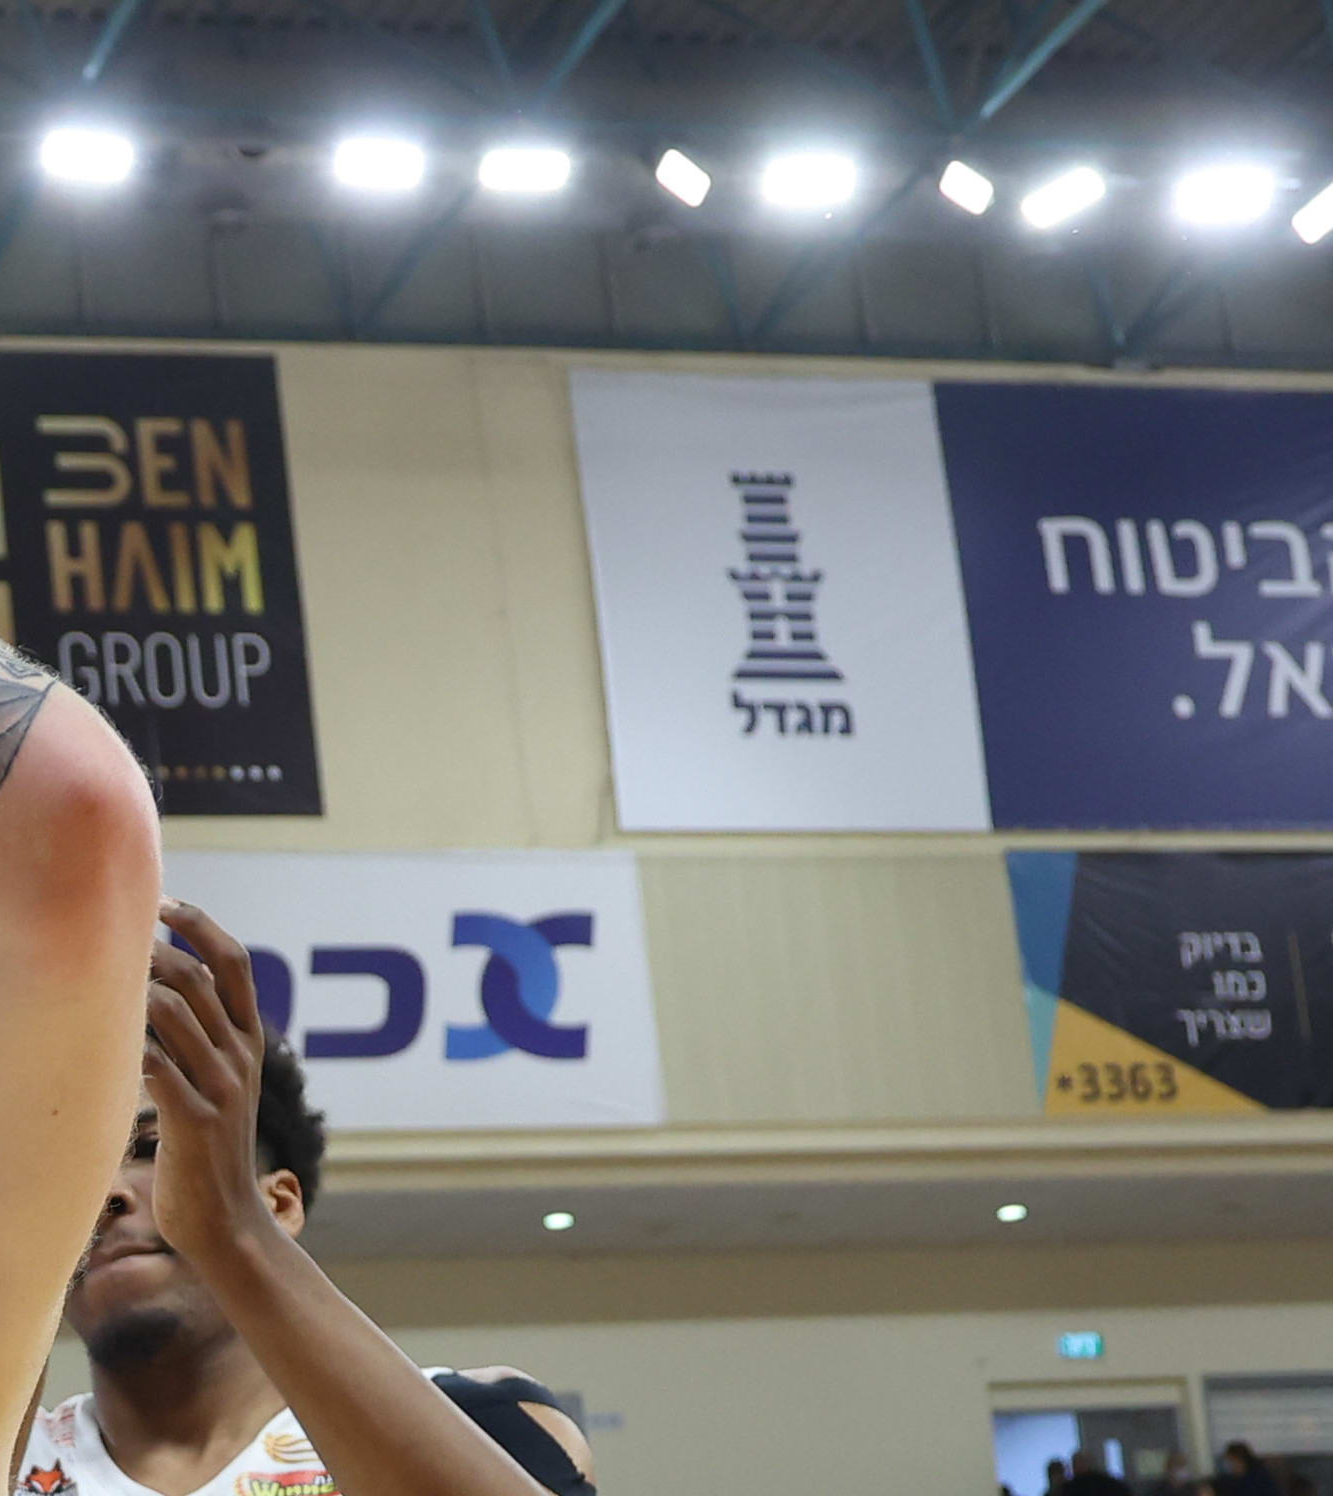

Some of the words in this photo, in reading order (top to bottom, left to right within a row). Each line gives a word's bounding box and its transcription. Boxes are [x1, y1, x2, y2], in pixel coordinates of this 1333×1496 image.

[46, 519, 263, 616] HAIM
[1037, 515, 1333, 598] ביטוח
[57, 631, 273, 709] GROUP
[1171, 620, 1333, 719] אל.
[731, 690, 854, 736] מגדל
[1178, 931, 1263, 969] בדיוק
[1211, 970, 1267, 1002] כמו
